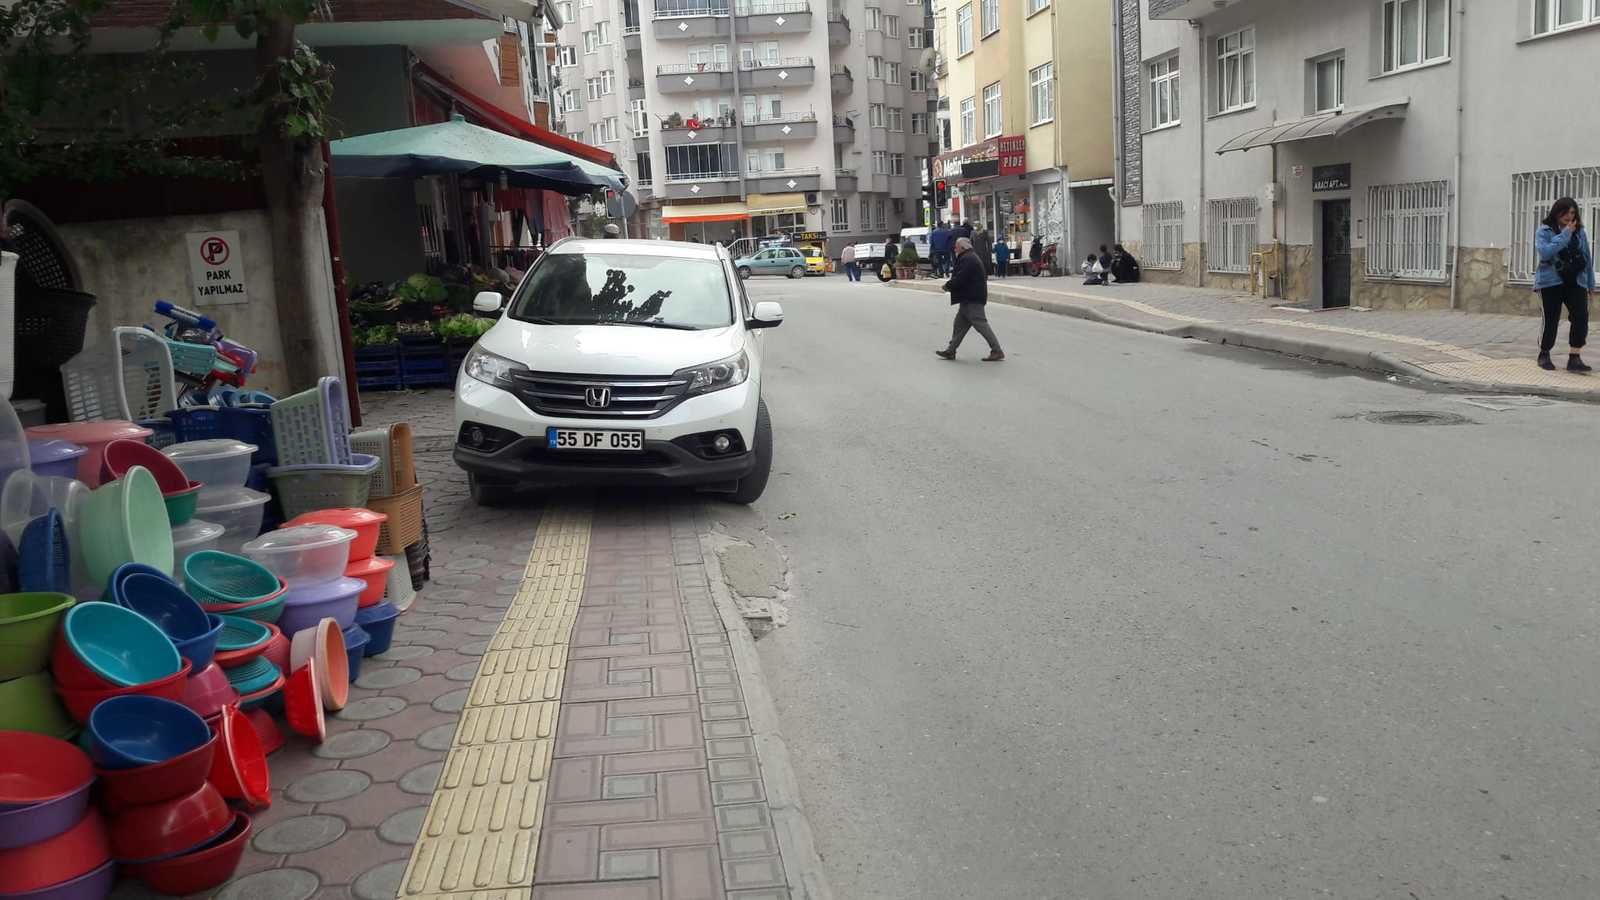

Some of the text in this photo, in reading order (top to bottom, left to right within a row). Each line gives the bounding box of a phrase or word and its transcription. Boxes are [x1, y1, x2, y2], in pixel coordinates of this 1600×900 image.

[206, 269, 231, 280] PARK
[198, 284, 244, 296] YAPILMAZ
[557, 431, 640, 448] 55 DF 055
